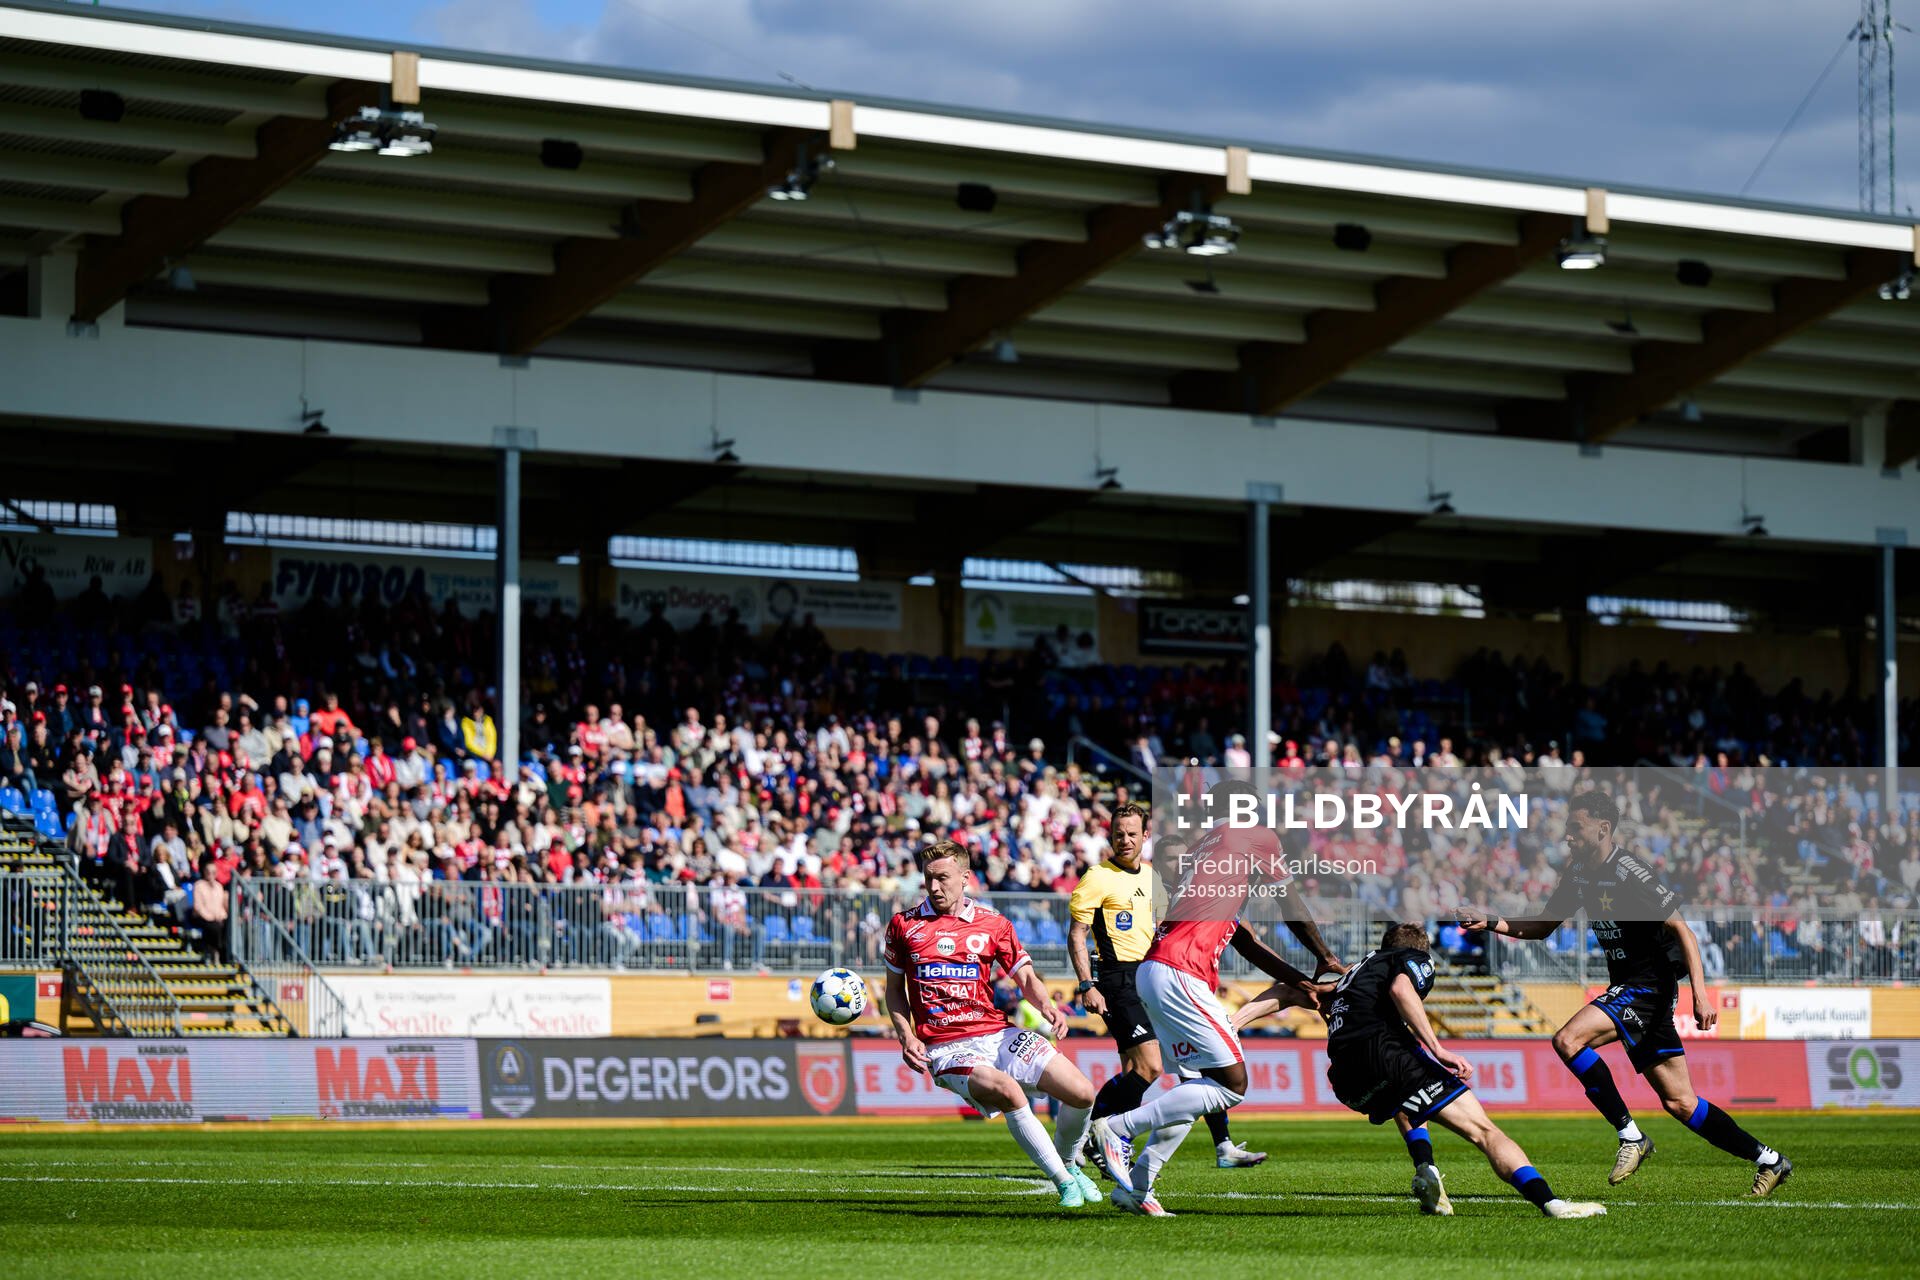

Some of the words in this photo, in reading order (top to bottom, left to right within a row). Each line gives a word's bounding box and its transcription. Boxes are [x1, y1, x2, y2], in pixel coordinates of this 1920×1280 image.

[917, 964, 977, 977] Helmia
[1172, 1040, 1198, 1057] ICA
[542, 1056, 790, 1101] DEGERFORS
[1827, 1046, 1903, 1091] SQS
